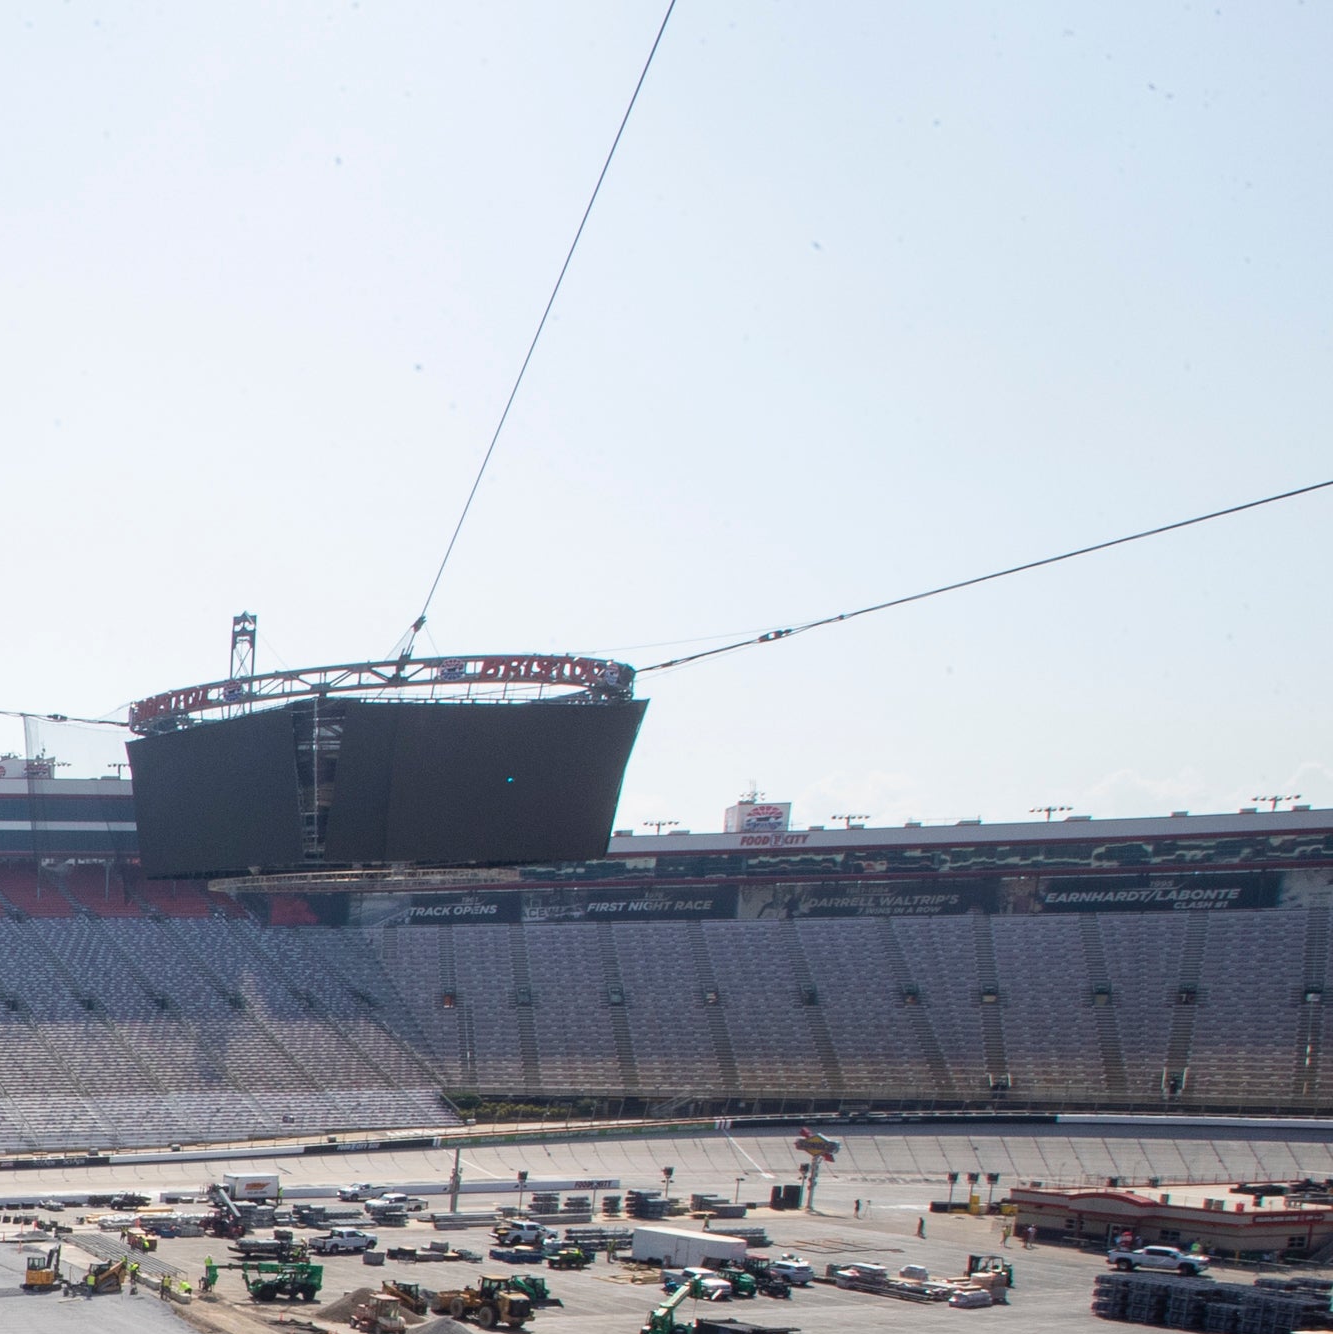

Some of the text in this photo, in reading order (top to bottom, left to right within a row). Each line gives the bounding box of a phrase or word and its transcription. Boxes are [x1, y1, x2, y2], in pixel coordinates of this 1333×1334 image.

[740, 834, 810, 846] FOOD CITY
[810, 894, 960, 909] DARRELL WALTRIP'S
[1045, 888, 1242, 904] EARNHARDT/LABONTE
[409, 904, 498, 917] TRACK OPENS
[587, 902, 627, 912] FIRST
[628, 901, 673, 912] NIGHT
[675, 900, 713, 911] RACE
[914, 906, 942, 914] ROW
[1173, 901, 1213, 910] CLASH
